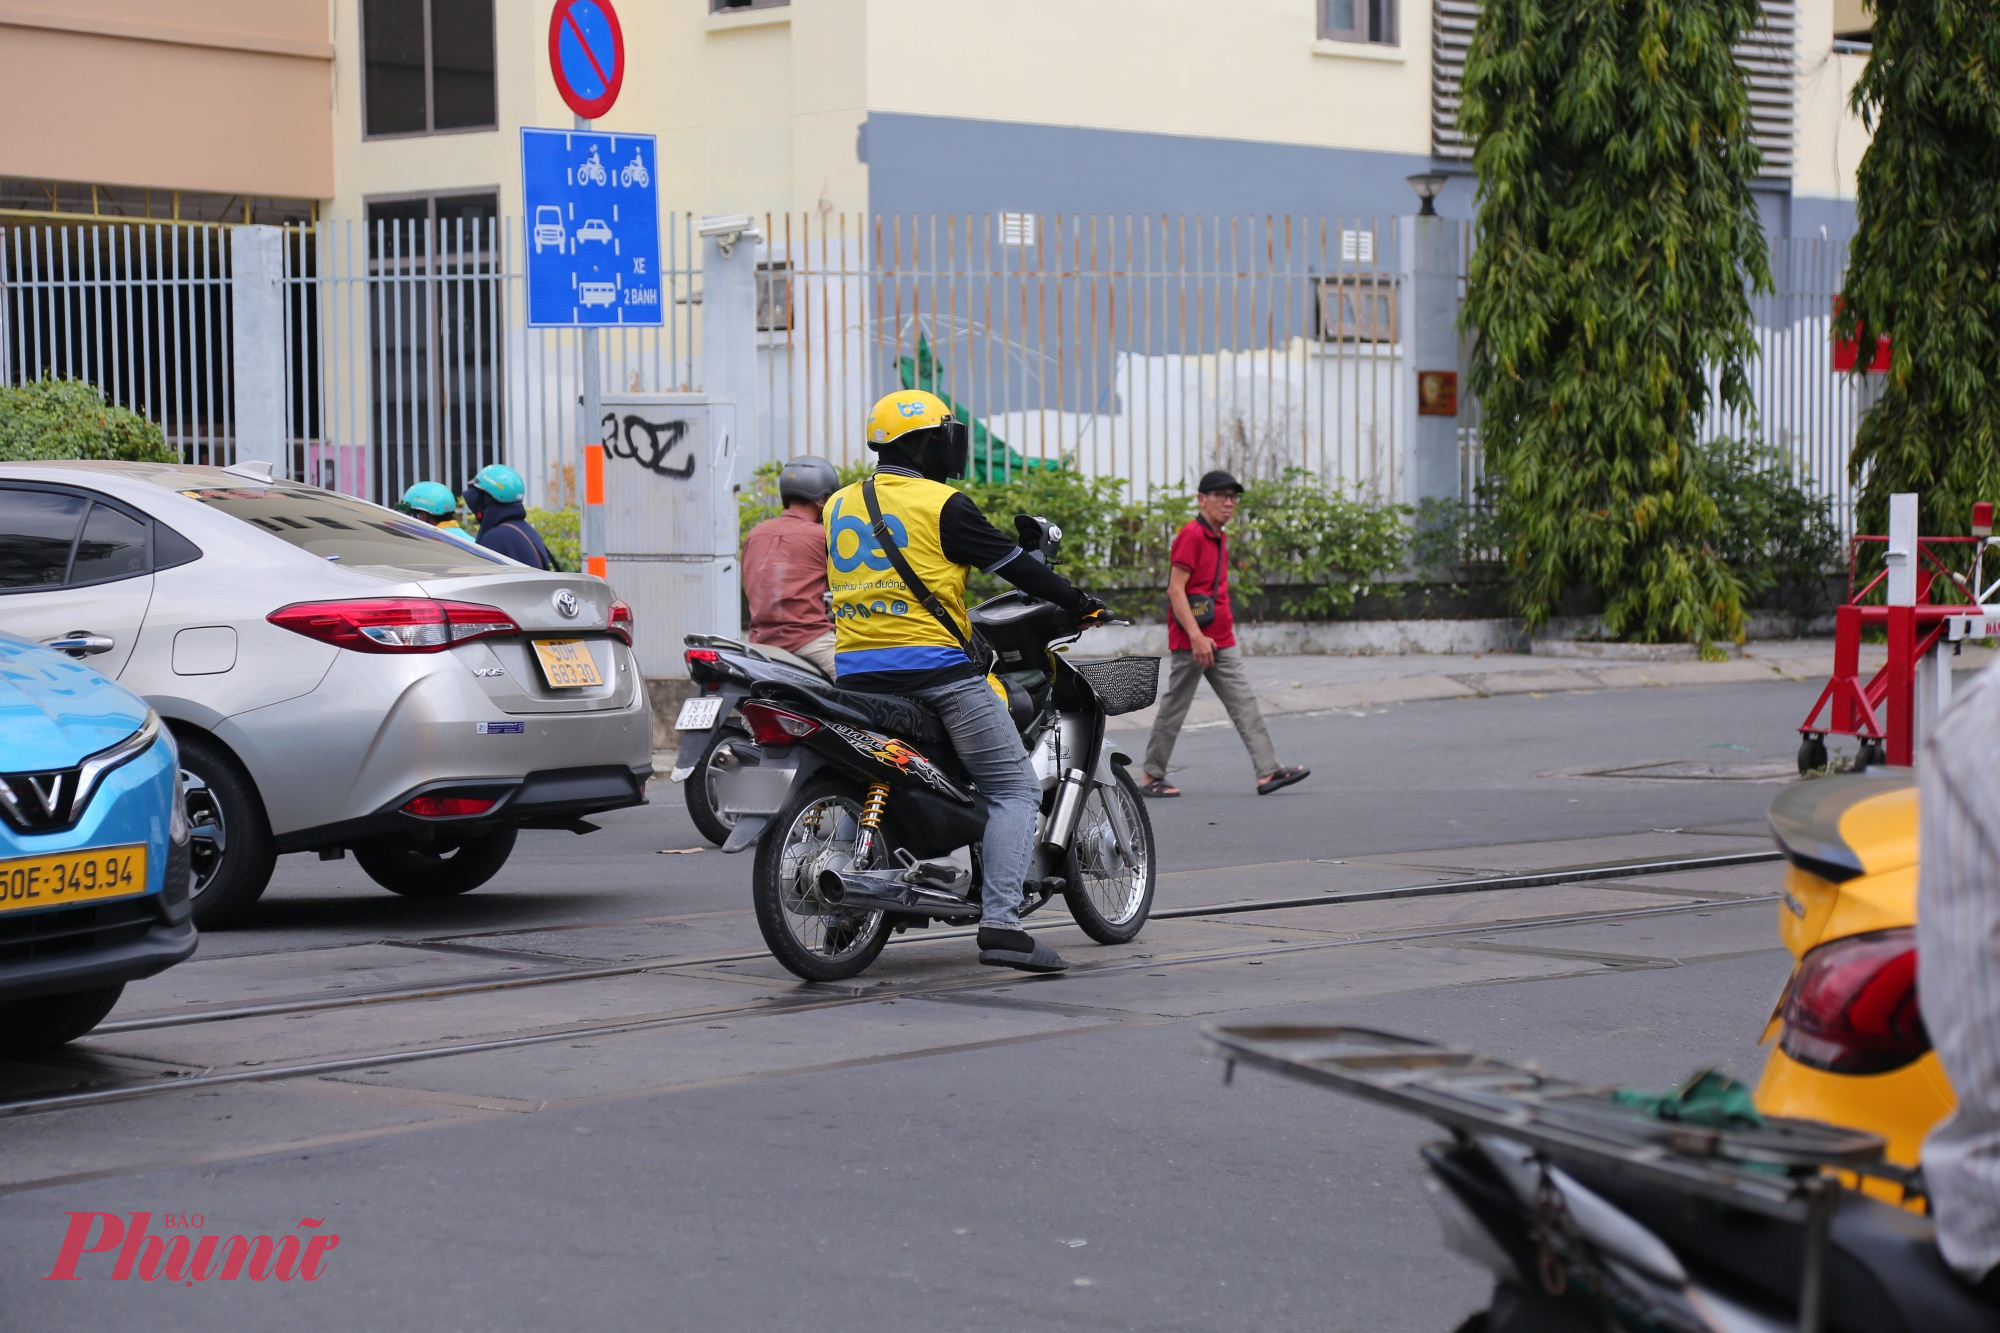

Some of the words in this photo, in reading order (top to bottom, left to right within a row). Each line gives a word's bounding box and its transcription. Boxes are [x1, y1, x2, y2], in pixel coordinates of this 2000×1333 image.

[633, 257, 646, 275] XE
[624, 288, 630, 305] 2
[631, 283, 658, 305] BÁNH
[897, 401, 925, 418] be
[830, 497, 909, 573] be
[875, 578, 907, 591] đường
[549, 641, 578, 661] 50H
[472, 667, 504, 678] VIOS
[551, 663, 596, 684] 683.30
[679, 714, 713, 728] 436.99
[0, 855, 132, 901] 50E-349.94
